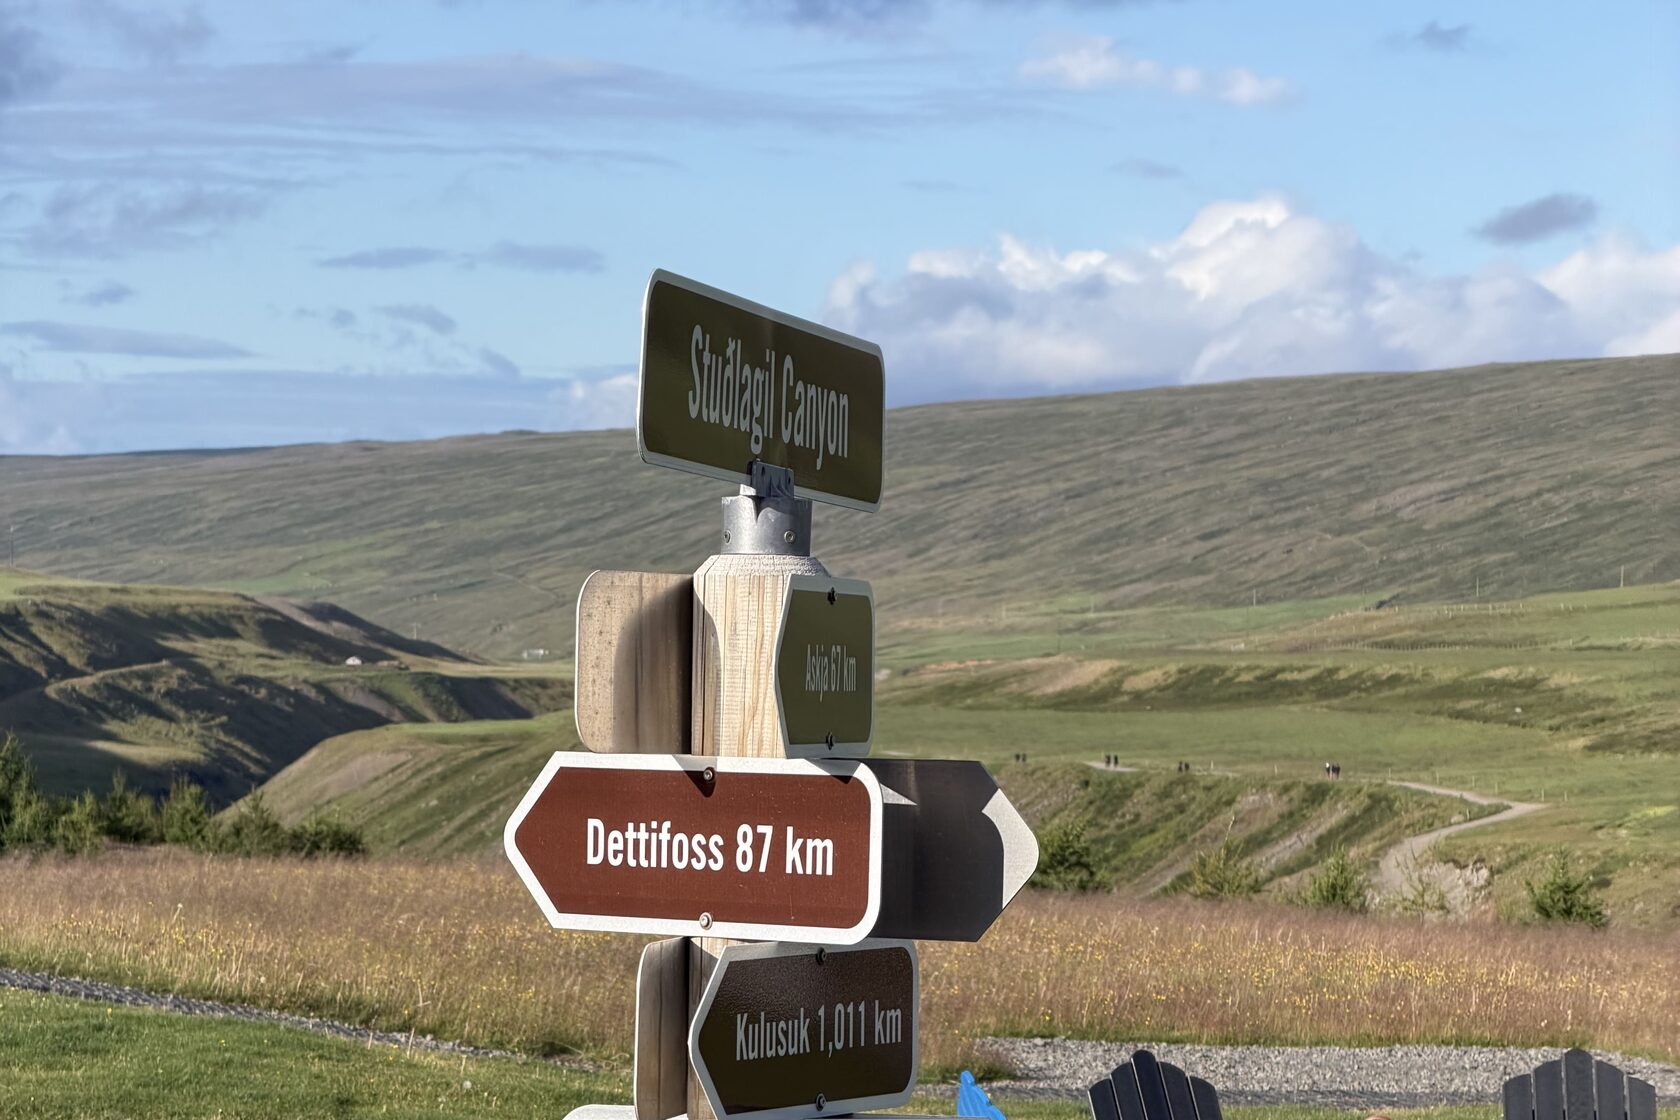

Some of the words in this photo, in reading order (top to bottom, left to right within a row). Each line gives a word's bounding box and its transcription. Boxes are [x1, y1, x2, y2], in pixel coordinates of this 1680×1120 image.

[688, 324, 775, 455] Stuðlagil
[781, 354, 849, 471] Canyon
[805, 643, 829, 702] Askja
[830, 644, 841, 692] 67
[843, 645, 858, 692] km
[586, 818, 724, 871] Dettifoss
[735, 823, 774, 873] 87
[785, 825, 834, 876] km
[736, 1007, 811, 1061] Kulusuk
[817, 1001, 866, 1058] 1,011
[874, 1000, 902, 1045] km
